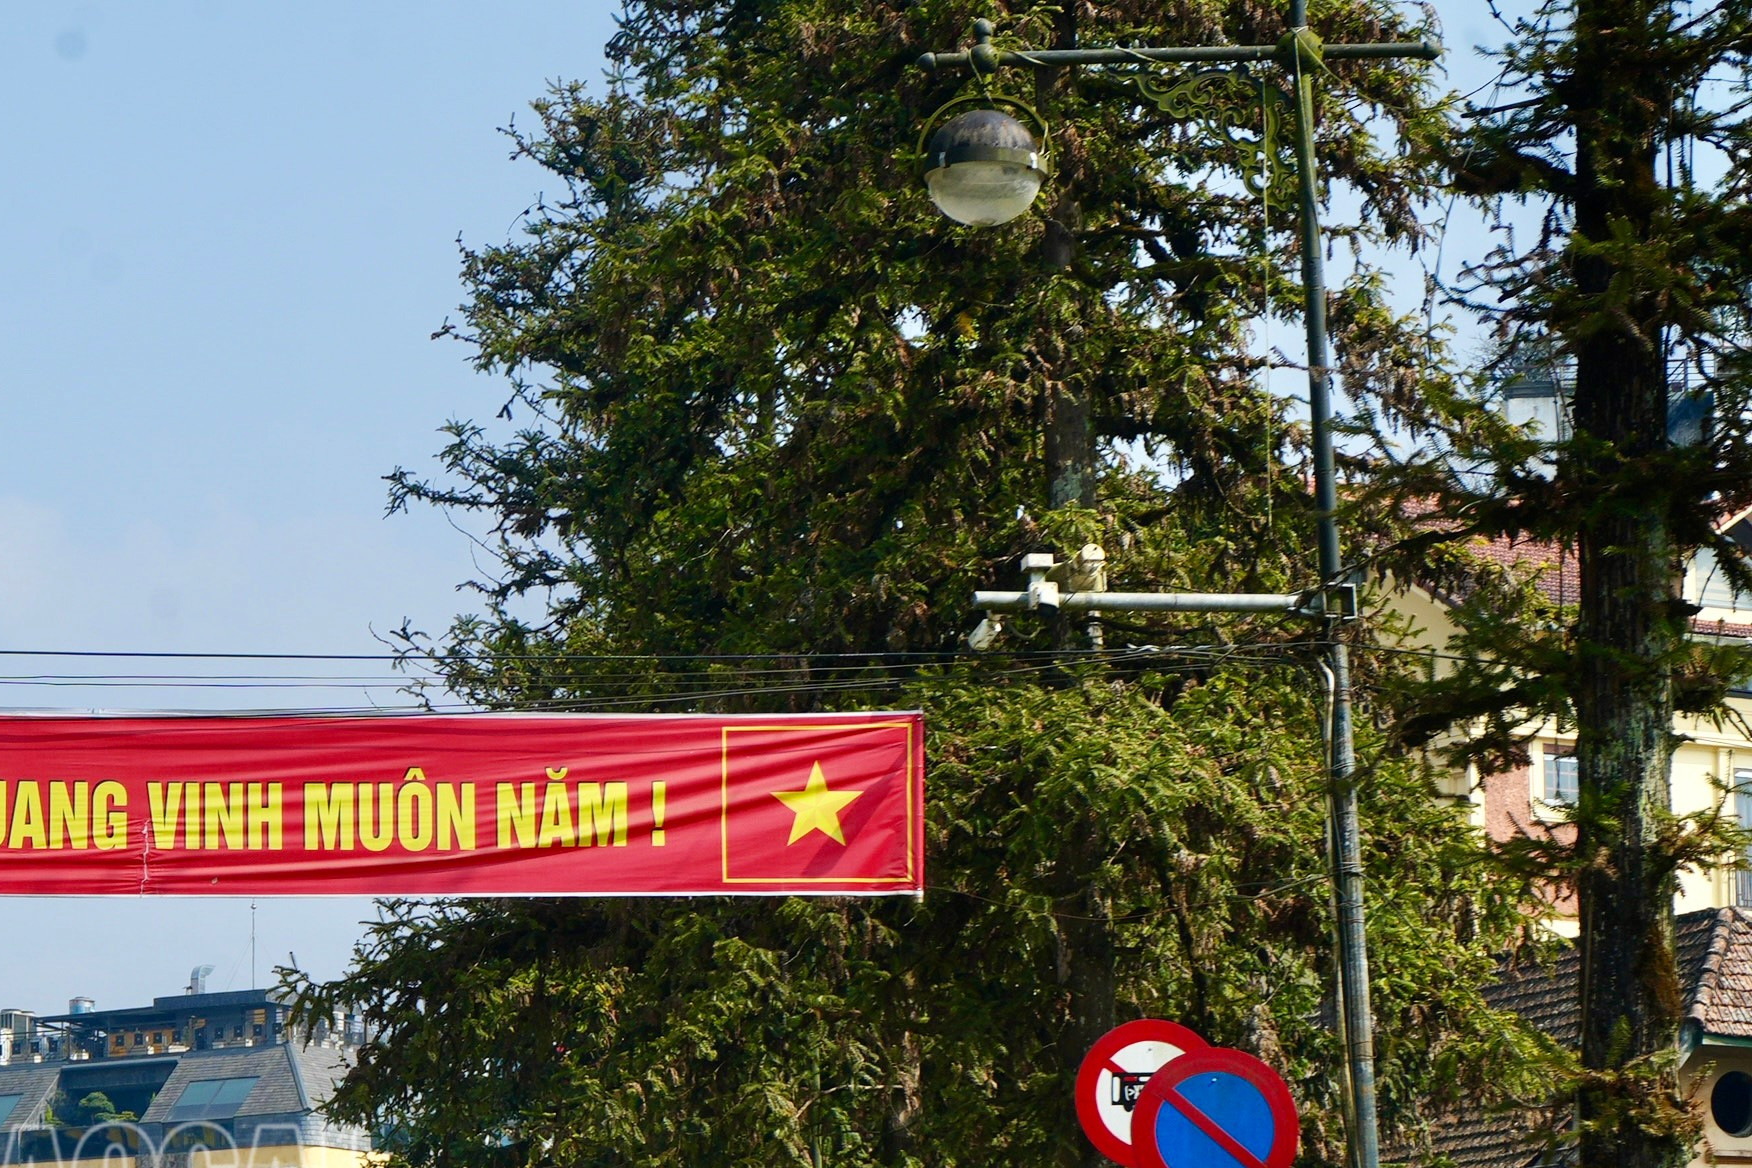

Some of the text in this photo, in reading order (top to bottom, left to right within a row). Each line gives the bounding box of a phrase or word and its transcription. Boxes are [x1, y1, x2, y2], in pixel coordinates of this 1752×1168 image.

[147, 781, 284, 851] VINH
[303, 766, 477, 853] MUÔN
[496, 766, 629, 849] NĂM
